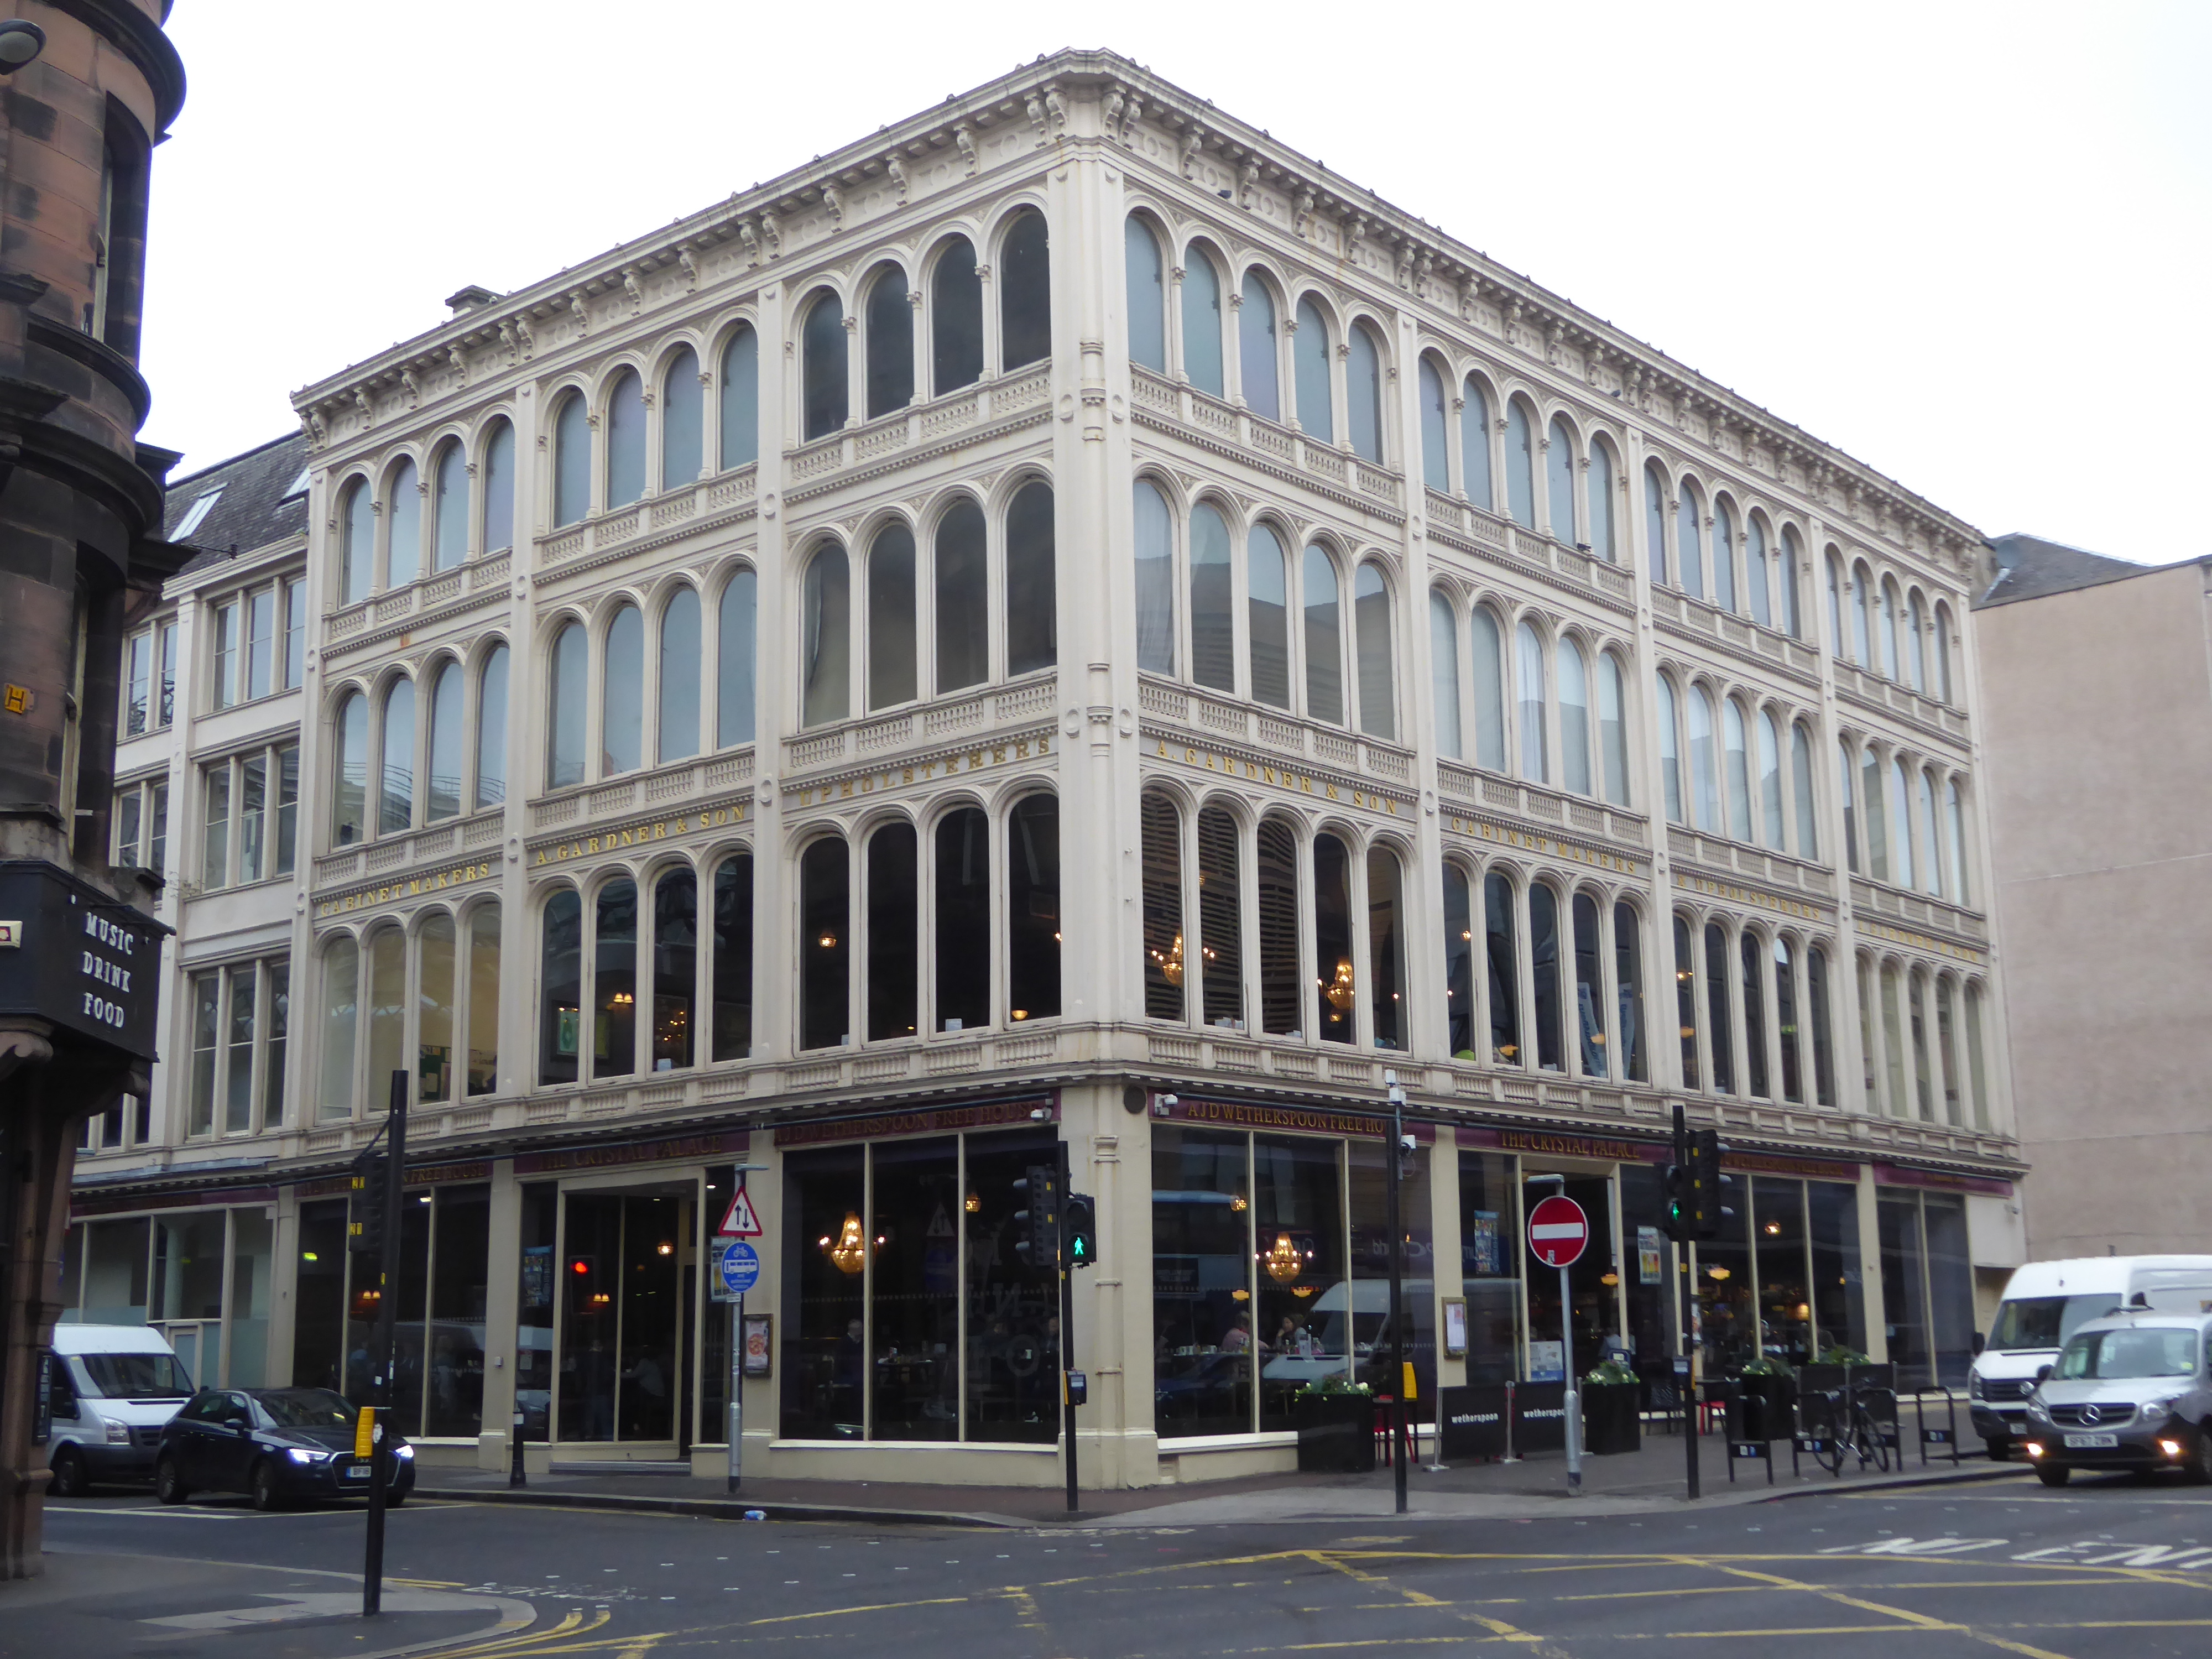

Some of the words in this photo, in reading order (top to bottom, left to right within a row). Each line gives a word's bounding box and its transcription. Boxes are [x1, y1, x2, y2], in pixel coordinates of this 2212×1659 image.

[800, 739, 1050, 806] UPHOLSTERERS
[1185, 748, 1312, 793] GARDNER
[1327, 783, 1338, 799] &
[1354, 791, 1397, 815] SON
[557, 822, 665, 860] GARDNER
[675, 818, 687, 834] &
[700, 805, 745, 828] SON
[1452, 817, 1546, 852] CABINET
[1557, 843, 1635, 874] MAKERS
[322, 883, 403, 916] CABINET
[410, 863, 489, 894] MAKERS
[85, 912, 134, 955] MUSIC
[82, 951, 131, 993] DRINK
[84, 992, 124, 1028] FOOD
[808, 1113, 928, 1139] WETHERSPOON
[934, 1108, 974, 1128] FREE
[1223, 1104, 1327, 1128] WETHERSPOON
[1330, 1115, 1362, 1131] FREE
[539, 1151, 567, 1170] THE
[573, 1144, 646, 1166] CRYSTAL
[654, 1135, 721, 1159] PALACE
[1501, 1132, 1526, 1148] THE
[1531, 1134, 1589, 1155] CRYSTAL
[1593, 1139, 1640, 1159] PALACE
[1451, 1412, 1499, 1424] wetherspoon
